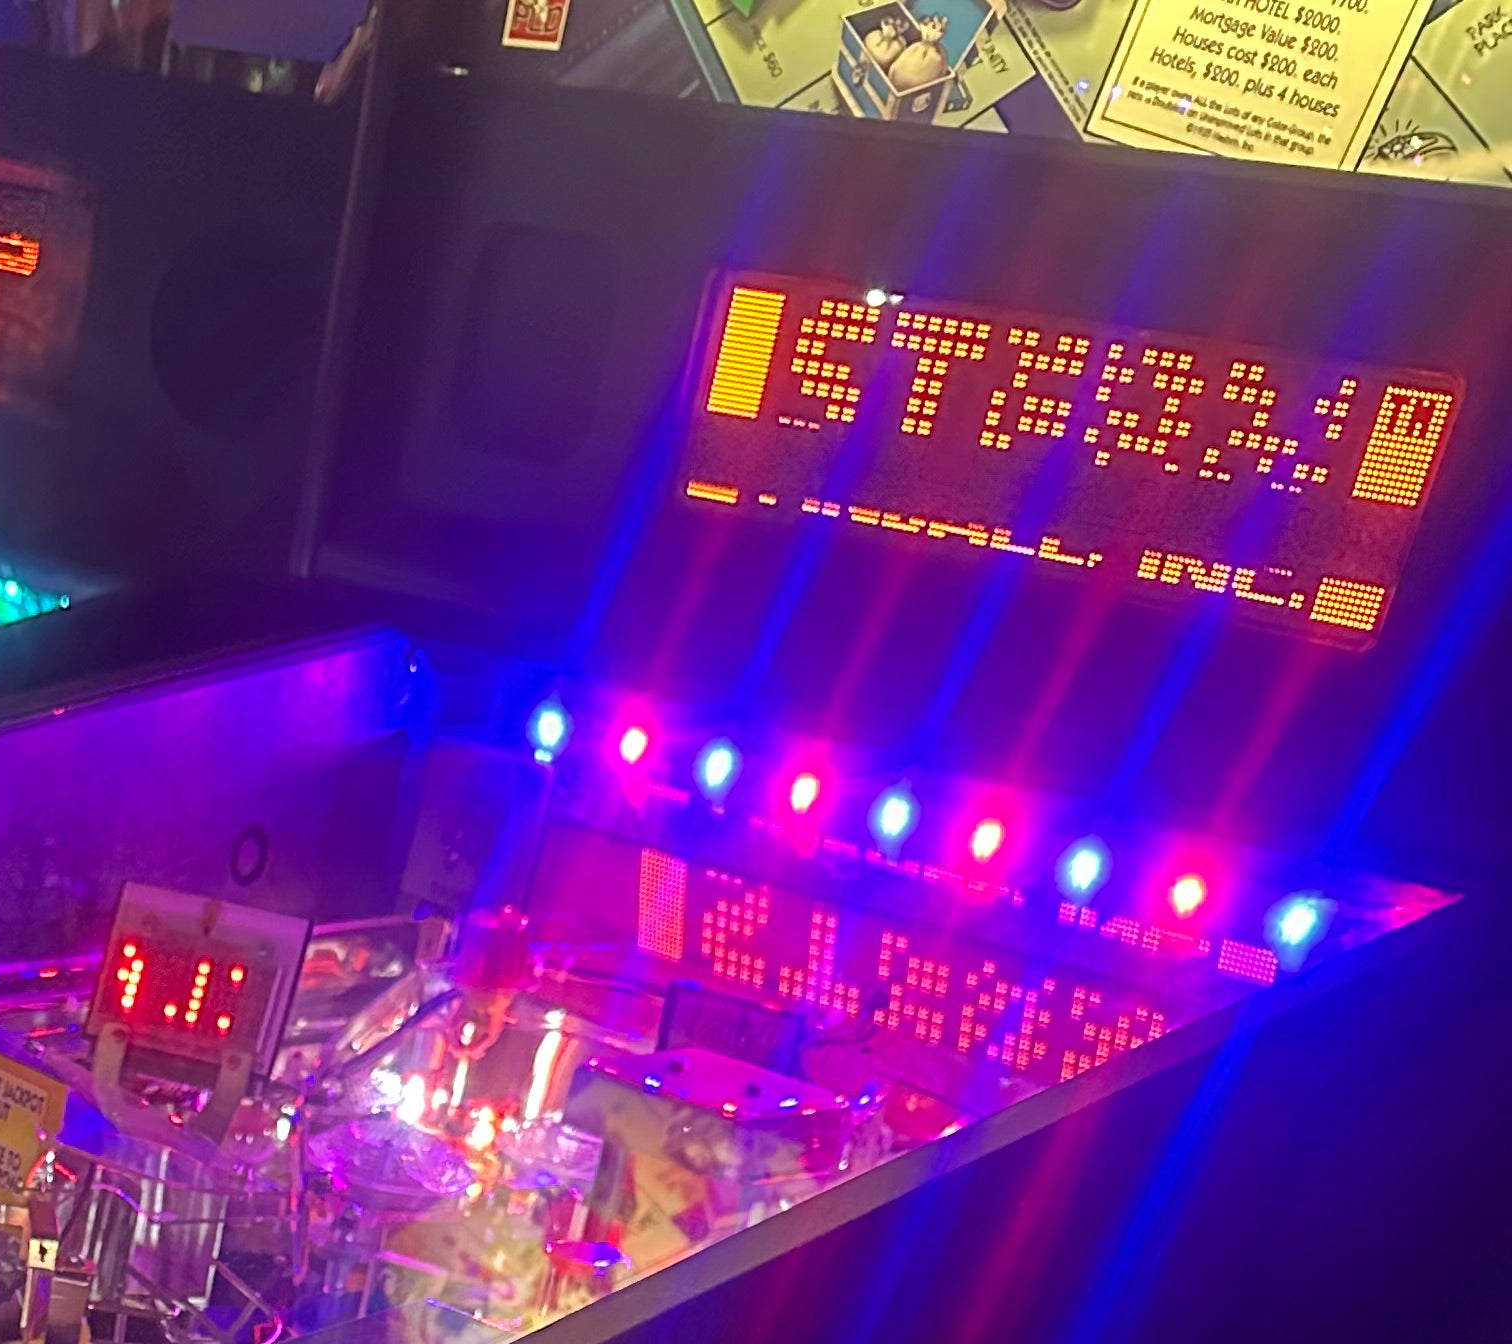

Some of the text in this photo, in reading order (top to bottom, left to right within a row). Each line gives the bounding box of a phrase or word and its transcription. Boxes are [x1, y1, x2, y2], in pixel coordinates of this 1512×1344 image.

[1189, 5, 1338, 62] Mortgage Value $200.
[1294, 5, 1341, 36] $2000.
[1465, 5, 1507, 41] PARK
[1149, 45, 1341, 117] Hotels, $200. plus 4 houses
[1172, 25, 1338, 90] Houses cost $200. each
